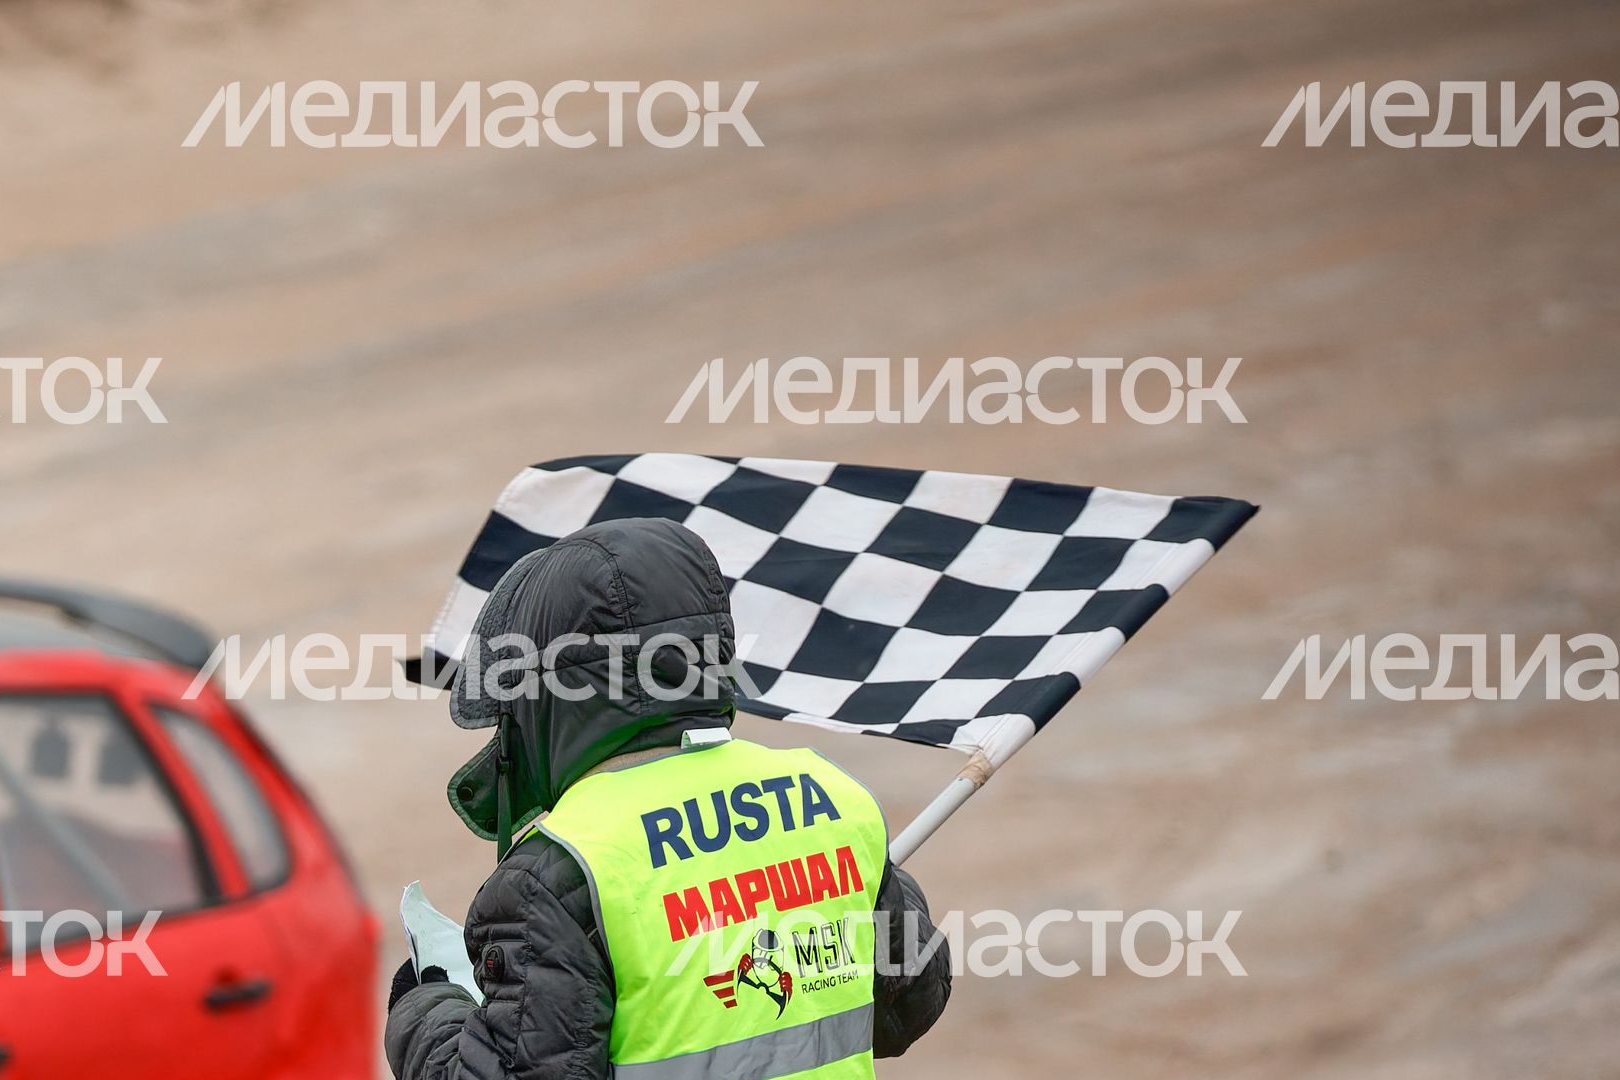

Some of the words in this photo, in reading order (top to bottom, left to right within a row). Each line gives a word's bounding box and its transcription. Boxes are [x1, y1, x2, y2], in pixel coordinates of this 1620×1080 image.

[640, 773, 842, 869] RUSTA
[662, 845, 864, 942] МАРШАЛ
[791, 917, 856, 978] MSK
[801, 978, 836, 995] RACING
[837, 970, 859, 985] TEAM
